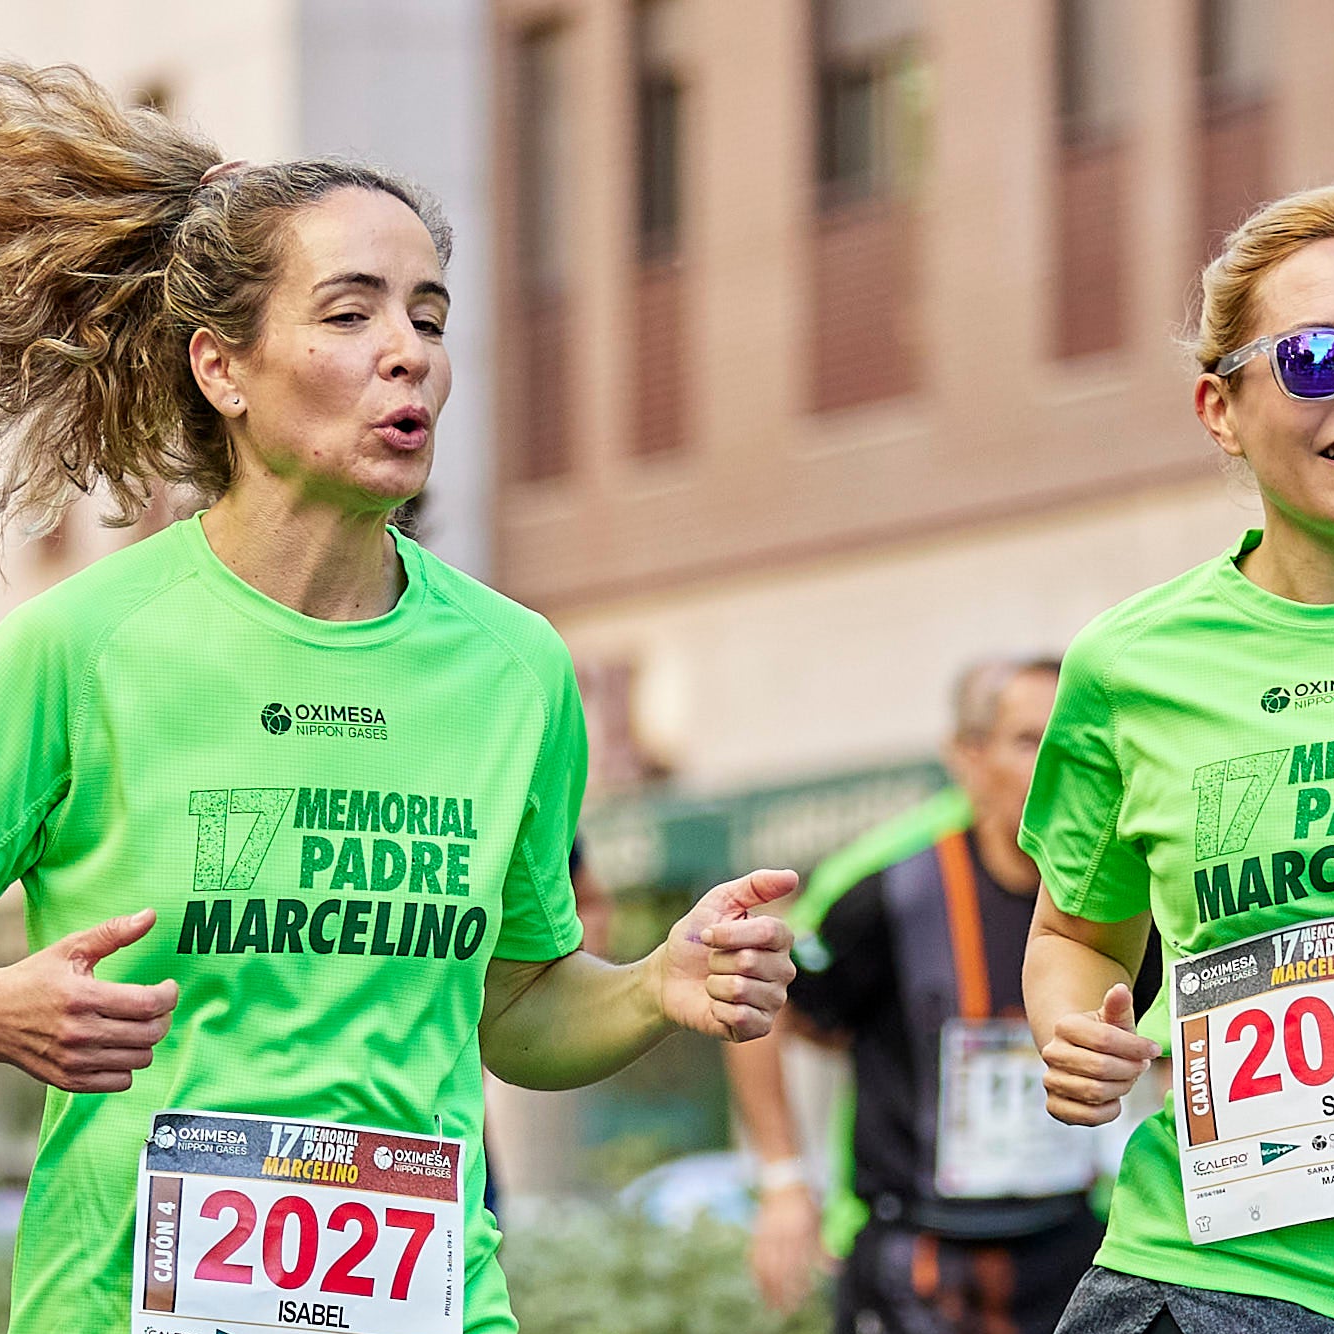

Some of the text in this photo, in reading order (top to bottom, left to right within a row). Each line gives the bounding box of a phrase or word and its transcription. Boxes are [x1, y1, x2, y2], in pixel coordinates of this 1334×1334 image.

[295, 704, 387, 725] OXIMESA
[296, 725, 388, 740] NIPPON GASES
[1192, 748, 1291, 863] 17
[188, 787, 478, 892] 17 MEMORIAL
[299, 834, 471, 897] PADRE
[175, 898, 488, 961] MARCELINO
[1271, 929, 1301, 968] 17
[1200, 954, 1258, 980] OXIMESA
[1200, 966, 1258, 992] NIPPON GASES
[1186, 1039, 1210, 1117] CAJÓN 4
[177, 1141, 248, 1156] NIPPON GASES
[178, 1127, 248, 1145] OXIMESA
[269, 1123, 359, 1158] 17 MEMORIAL
[301, 1140, 355, 1165] PADRE
[394, 1149, 452, 1169] OXIMESA
[1196, 1153, 1248, 1173] CALERO
[260, 1156, 359, 1185] MARCELINO
[393, 1162, 452, 1180] NIPPON GASES
[1307, 1166, 1329, 1176] SARA
[150, 1201, 176, 1283] CAJÓN 4
[193, 1188, 436, 1301] 2027
[277, 1299, 350, 1330] ISABEL
[444, 1284, 453, 1317] PRUEBA
